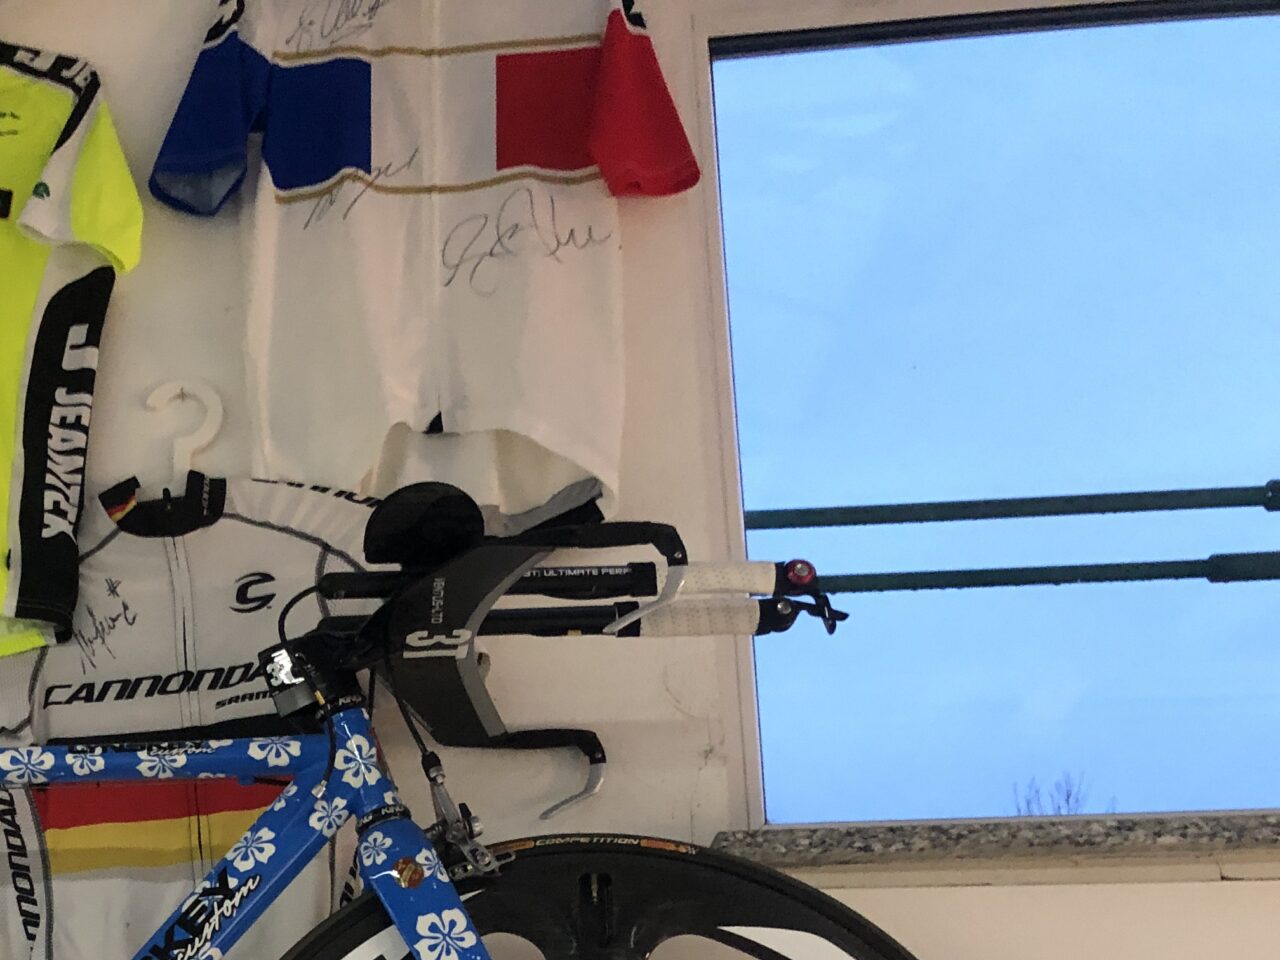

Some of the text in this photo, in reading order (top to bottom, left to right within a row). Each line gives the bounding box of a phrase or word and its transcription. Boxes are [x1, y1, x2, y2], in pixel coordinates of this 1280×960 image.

[543, 568, 599, 577] ULTIMATE
[402, 628, 473, 660] 3T
[534, 836, 641, 848] COMPETITION
